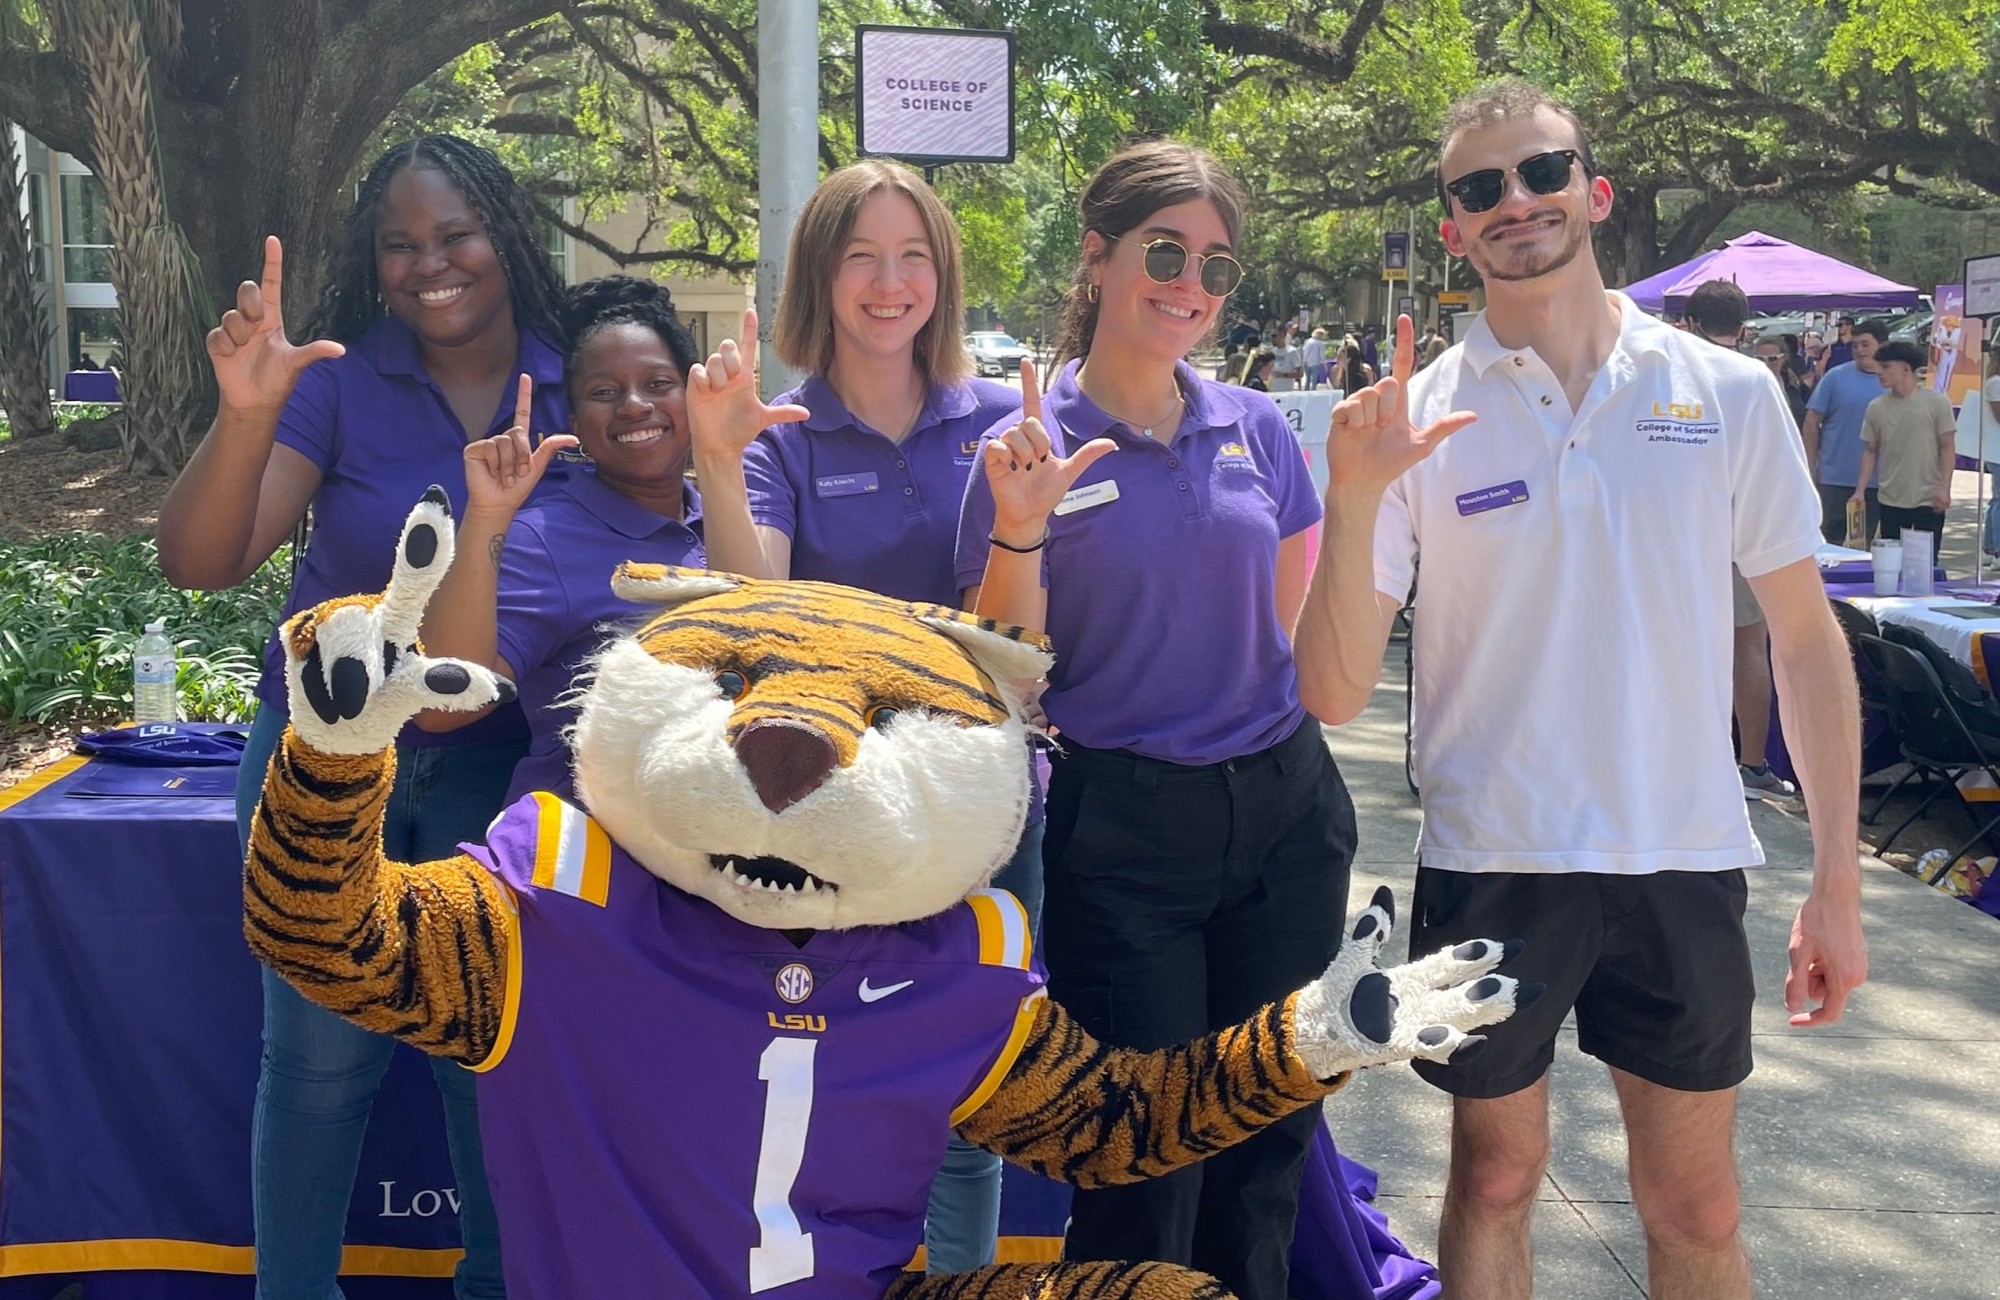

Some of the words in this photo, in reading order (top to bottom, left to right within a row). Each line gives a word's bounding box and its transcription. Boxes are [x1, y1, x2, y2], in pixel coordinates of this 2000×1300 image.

[886, 78, 960, 92] COLLEGE
[966, 82, 988, 93] OF
[901, 98, 973, 112] SCIENCE
[1653, 401, 1702, 419] LSU
[1636, 424, 1672, 433] College
[1684, 426, 1719, 434] Science
[961, 440, 979, 453] LS
[1648, 435, 1709, 445] Ambassador
[1459, 494, 1489, 505] Houston
[1489, 488, 1510, 499] Smith
[139, 725, 176, 738] LSU
[779, 966, 810, 1000] SEC
[767, 1011, 827, 1032] LSU
[749, 1036, 818, 1295] 1
[378, 1181, 460, 1217] Lov
